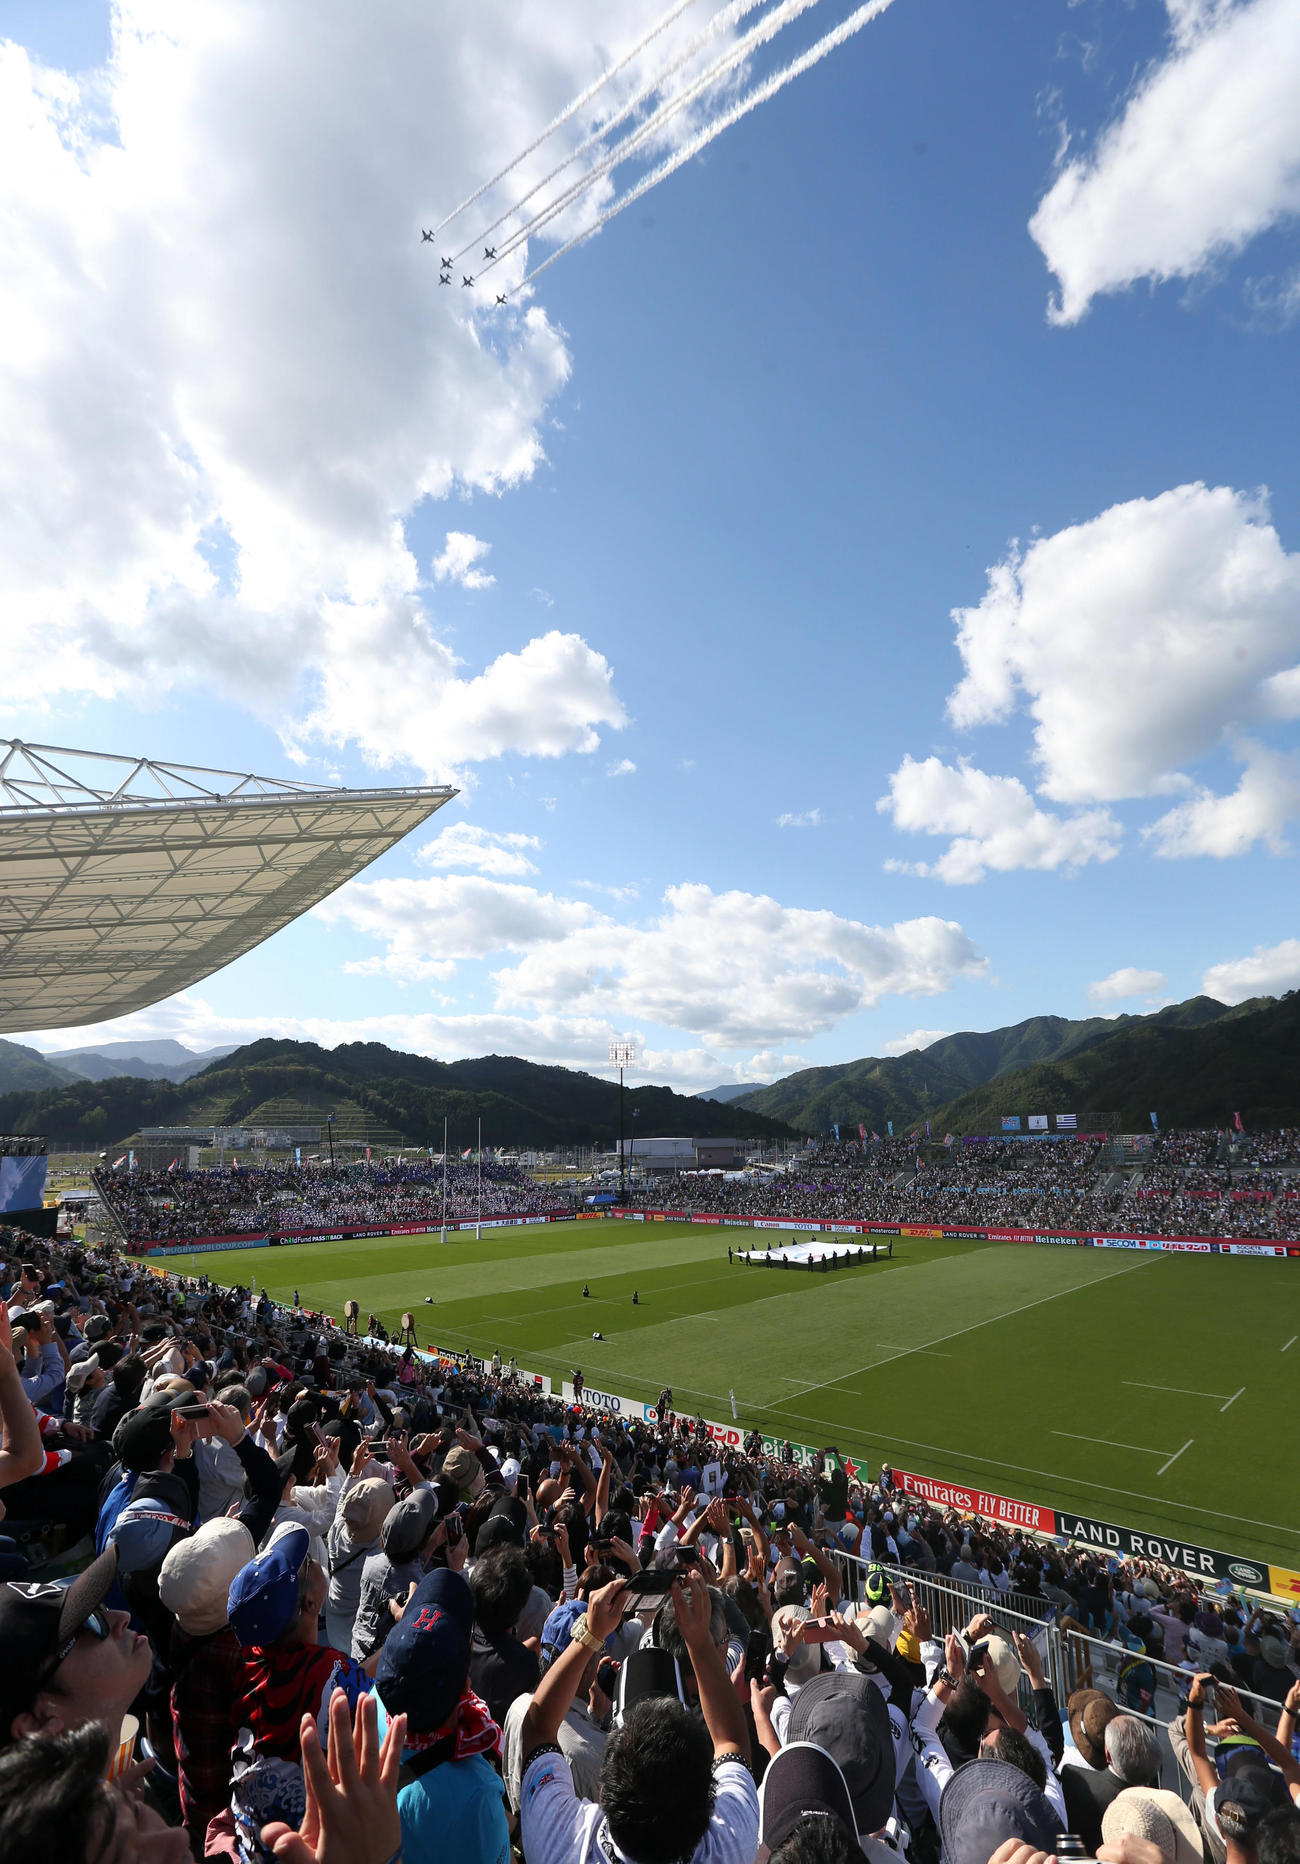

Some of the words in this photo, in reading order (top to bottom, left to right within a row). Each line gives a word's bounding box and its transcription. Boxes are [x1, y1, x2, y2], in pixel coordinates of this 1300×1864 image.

[724, 1219, 750, 1227] Heineken
[909, 1229, 934, 1237] DHL
[988, 1233, 1011, 1241] Emirates
[280, 1235, 311, 1245] ChildFund
[1035, 1235, 1076, 1245] Heineken
[1106, 1239, 1136, 1248] SECOM
[503, 1365, 524, 1379] SOTE
[583, 1389, 621, 1412] TOTO
[903, 1474, 972, 1508] Emirates
[978, 1494, 996, 1518] FLY
[1000, 1501, 1040, 1527] BETTER
[1060, 1516, 1120, 1547] LAND
[1130, 1534, 1216, 1574] ROVER
[412, 1608, 443, 1631] H
